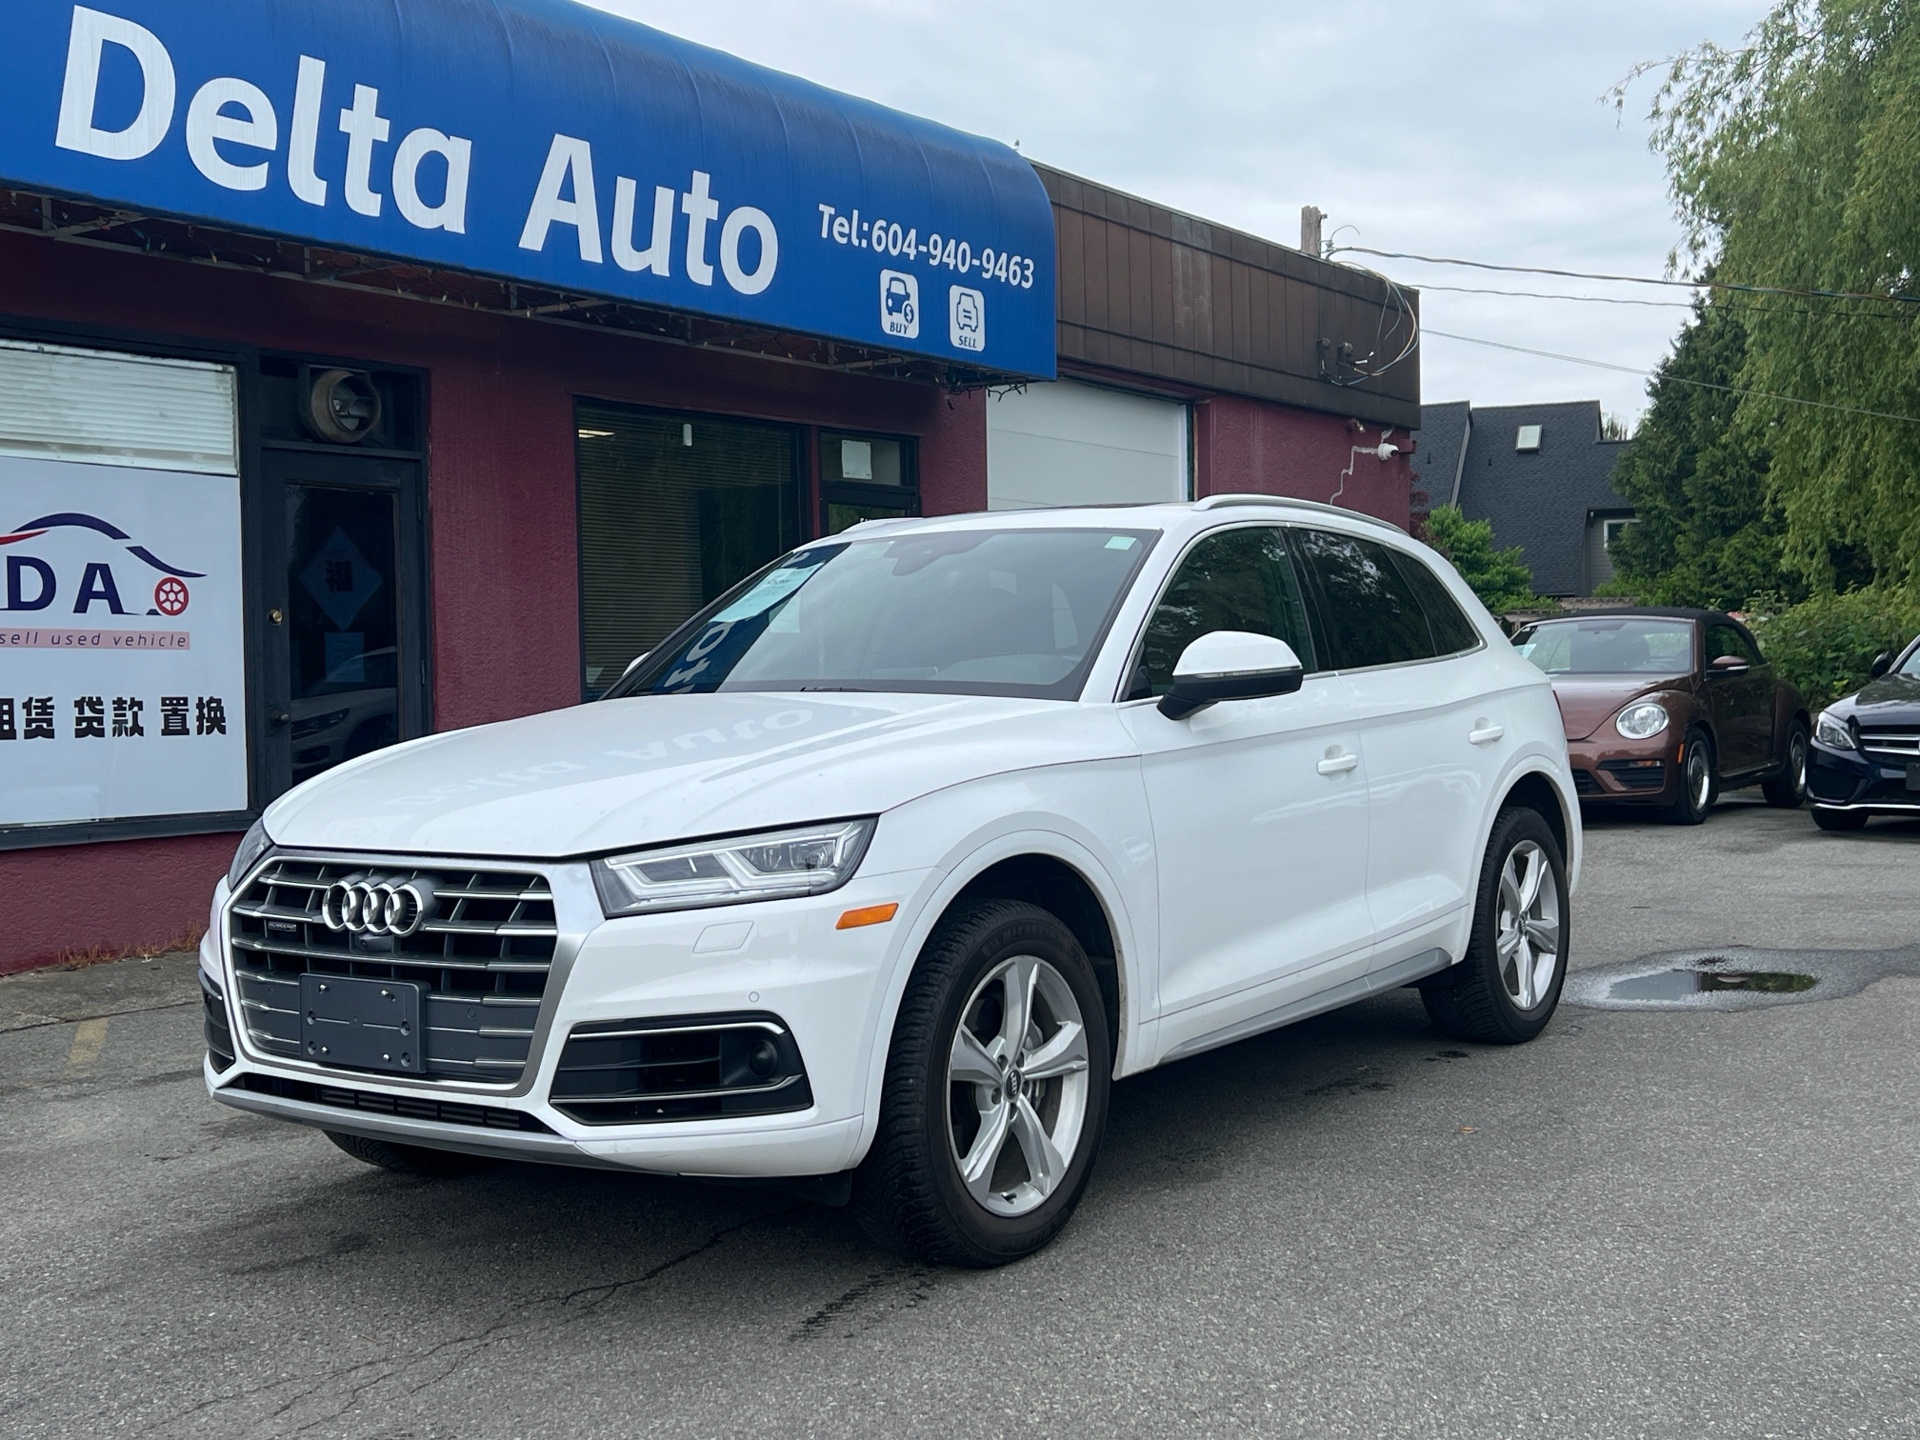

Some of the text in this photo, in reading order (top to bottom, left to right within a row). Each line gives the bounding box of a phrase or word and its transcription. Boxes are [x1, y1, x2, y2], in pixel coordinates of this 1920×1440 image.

[55, 4, 779, 296] Delta Auto
[818, 203, 1035, 290] Tel:604-940-9463
[889, 321, 910, 335] BUY
[958, 335, 977, 349] SELL
[0, 631, 186, 648] sell used vehicle
[74, 696, 145, 738] 贷款
[160, 696, 227, 736] 置换
